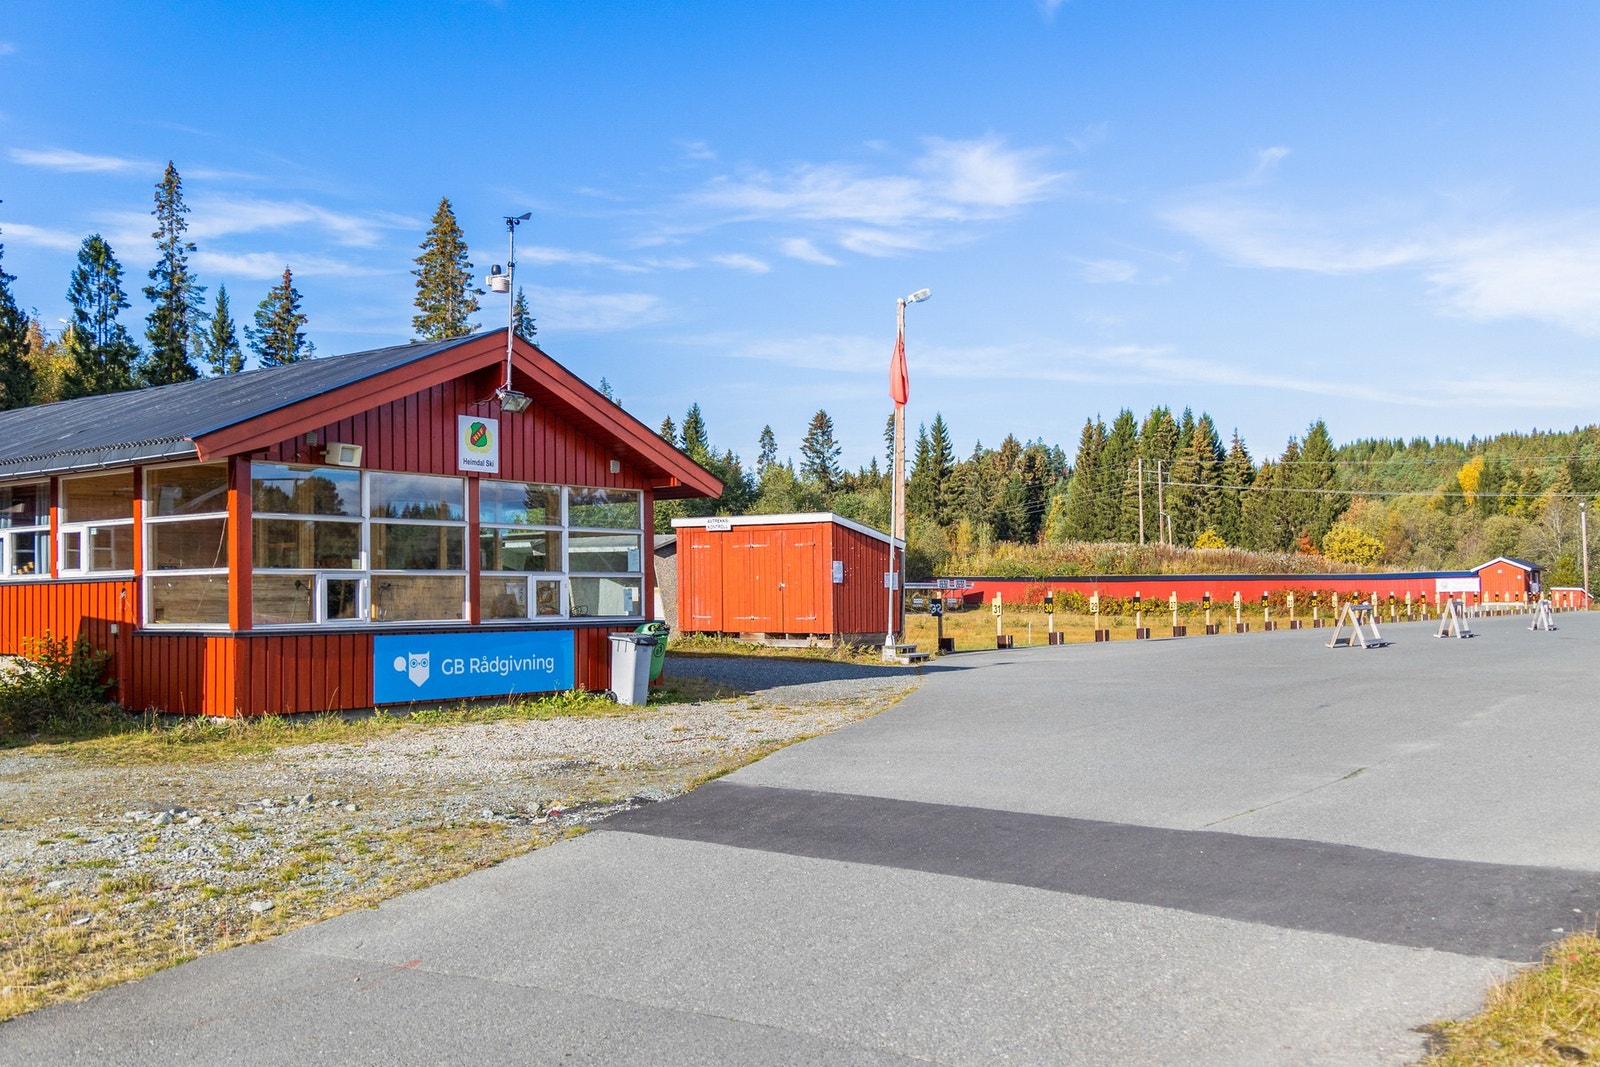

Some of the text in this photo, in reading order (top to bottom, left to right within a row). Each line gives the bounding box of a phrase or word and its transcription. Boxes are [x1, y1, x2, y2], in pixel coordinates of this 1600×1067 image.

[463, 458, 495, 468] Heimdal Ski
[931, 603, 943, 613] 32
[993, 604, 1001, 614] 31
[1044, 603, 1053, 613] 30
[441, 654, 554, 676] GB Rådgivning
